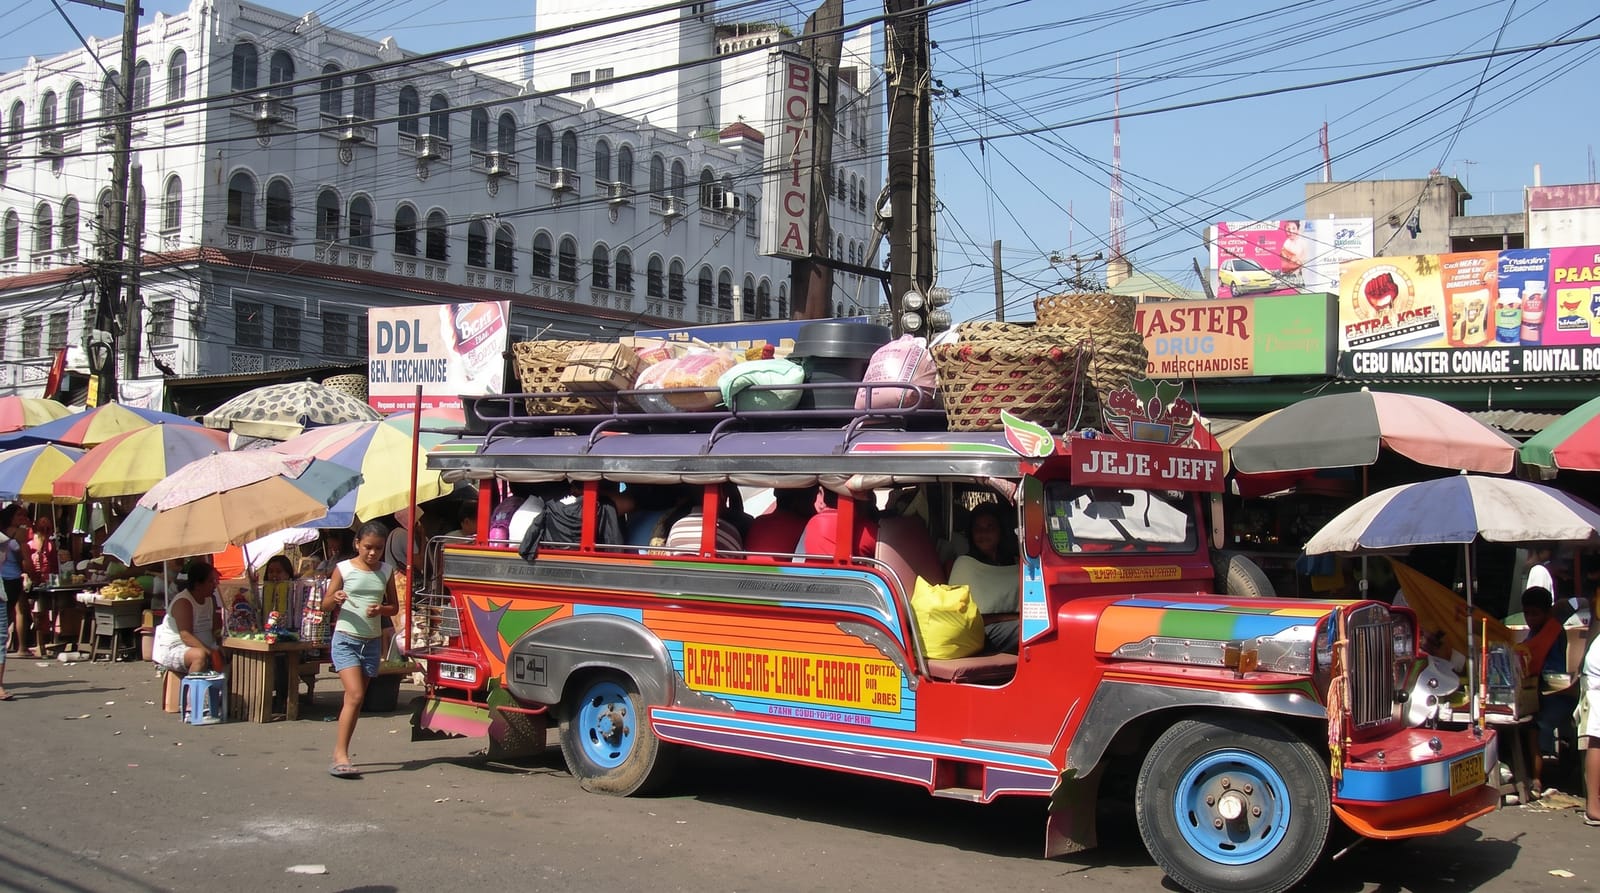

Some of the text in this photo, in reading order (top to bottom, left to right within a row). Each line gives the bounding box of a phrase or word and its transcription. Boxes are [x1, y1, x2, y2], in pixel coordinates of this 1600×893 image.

[781, 63, 810, 250] BOTICA
[377, 319, 428, 354] DDL
[1155, 336, 1215, 355] DRUG
[391, 358, 447, 383] MERCHANDISE
[1161, 358, 1249, 374] MERCHANDISE
[1352, 352, 1388, 374] CEBU
[1391, 352, 1449, 374] MASTER
[1452, 351, 1510, 374] CONAGE
[1523, 349, 1579, 372] RUNTAL
[1082, 450, 1217, 481] JEJE JEFF
